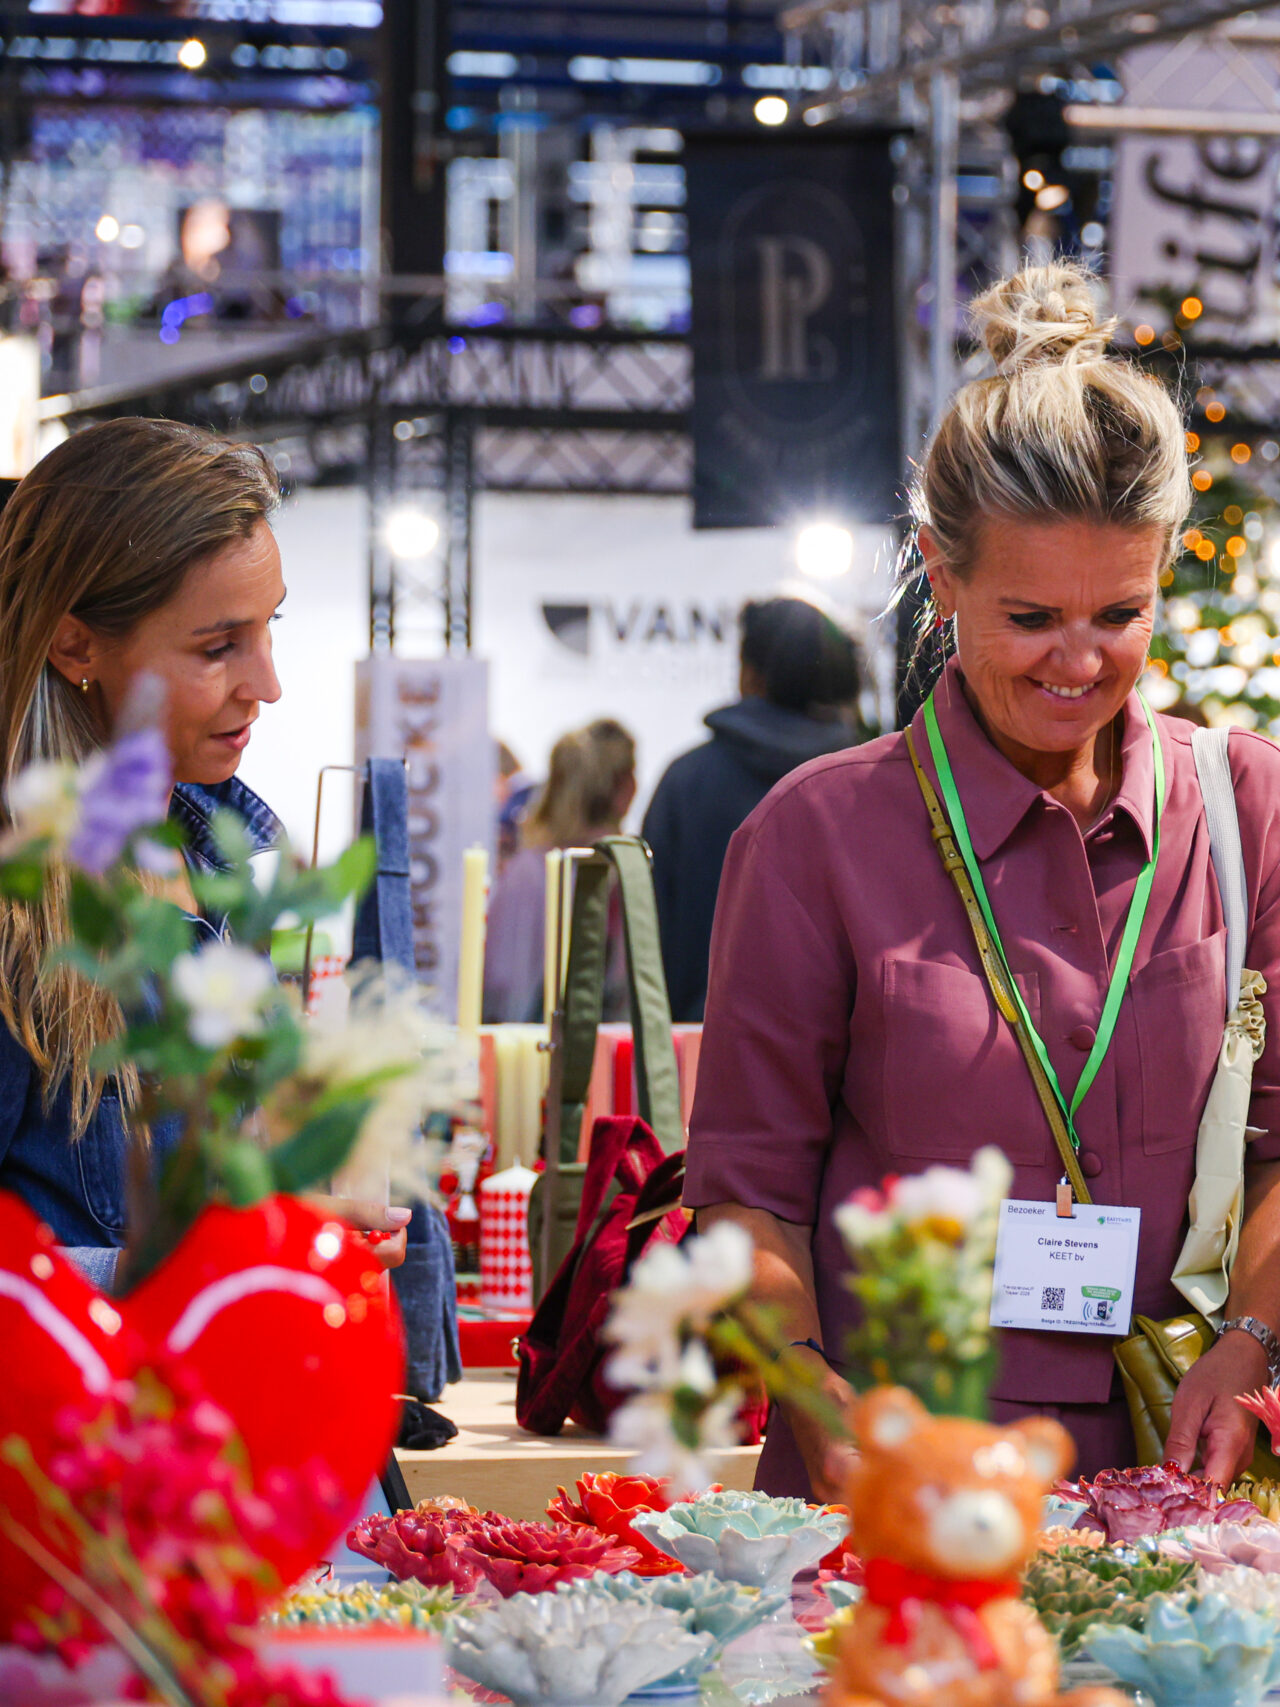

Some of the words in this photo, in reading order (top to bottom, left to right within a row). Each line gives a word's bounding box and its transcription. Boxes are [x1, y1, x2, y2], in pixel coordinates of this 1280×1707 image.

[1007, 1204, 1046, 1215] Bezoeker
[1037, 1237, 1063, 1247] Claire
[1064, 1239, 1099, 1249] Stevens
[1049, 1251, 1073, 1261] KEET
[1074, 1253, 1085, 1261] bv
